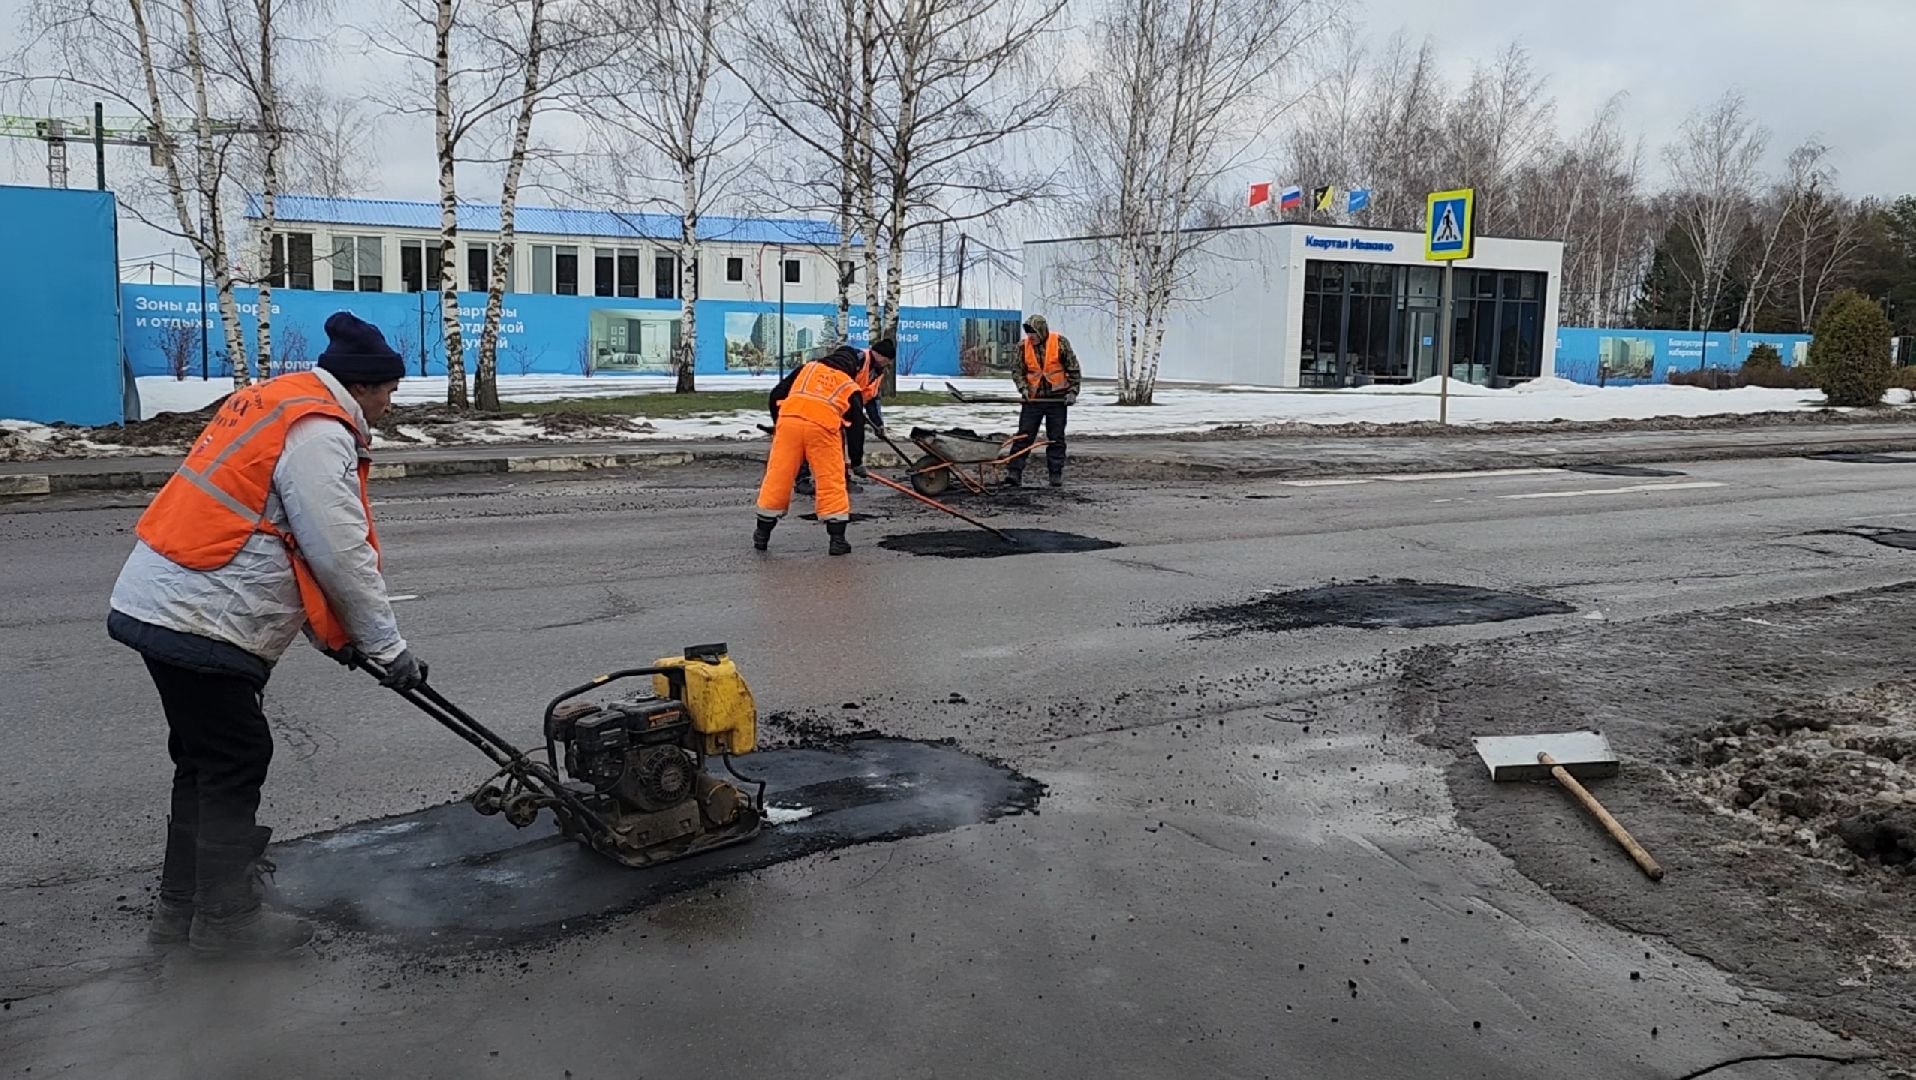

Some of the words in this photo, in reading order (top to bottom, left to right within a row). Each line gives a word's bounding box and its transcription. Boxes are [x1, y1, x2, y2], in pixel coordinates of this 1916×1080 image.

[135, 296, 182, 311] Зоны
[185, 302, 218, 314] дя
[233, 303, 280, 316] пора
[136, 318, 147, 327] и
